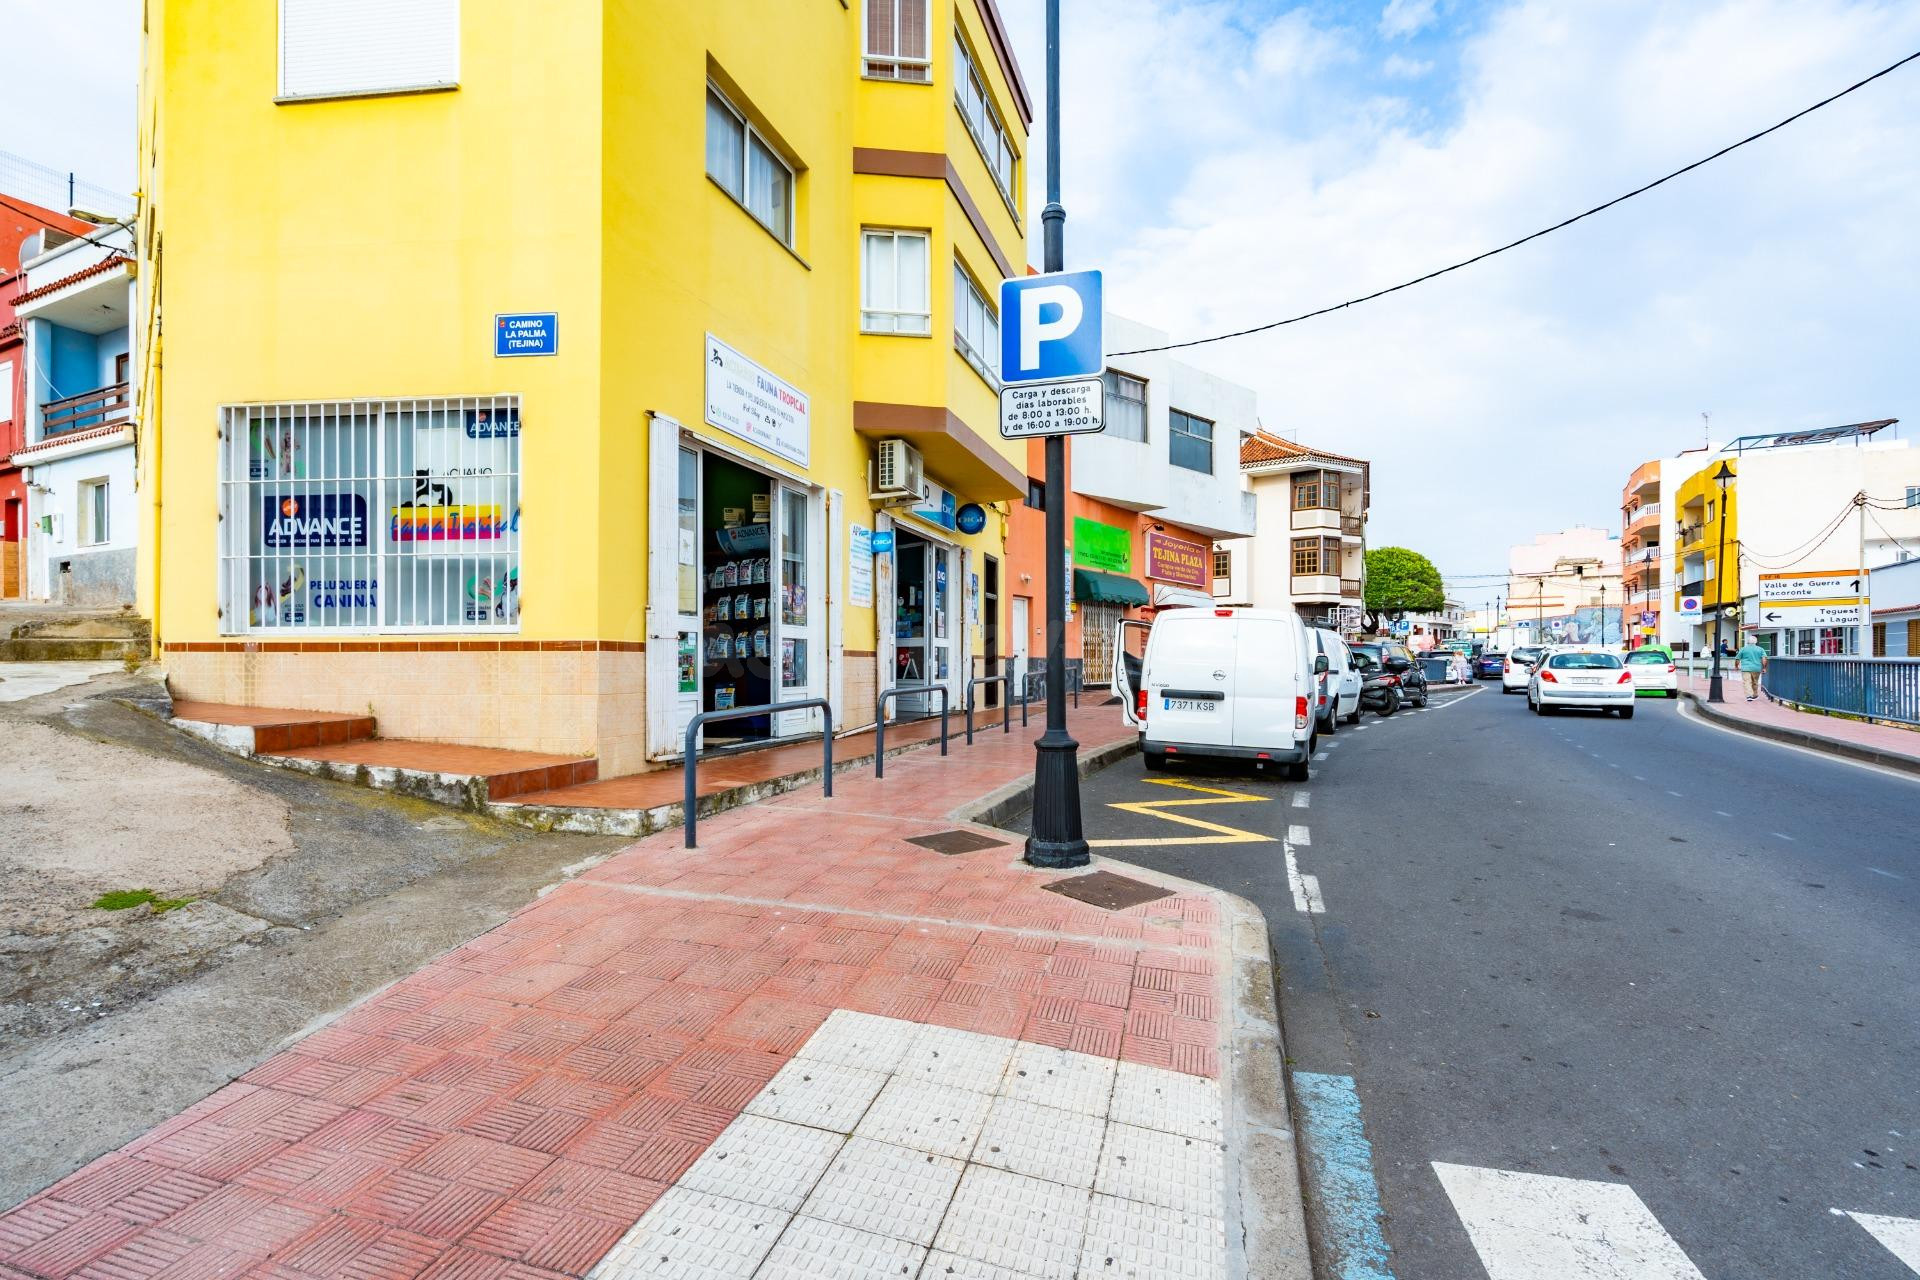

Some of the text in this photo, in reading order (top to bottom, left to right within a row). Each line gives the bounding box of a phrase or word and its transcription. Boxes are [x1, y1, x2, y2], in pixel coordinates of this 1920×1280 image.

[509, 320, 543, 328] CAMINO
[1020, 285, 1083, 371] P
[518, 329, 547, 338] PALMA
[508, 339, 543, 349] (TEJINA)
[756, 375, 806, 415] FAUNA TROPICAL
[1012, 385, 1091, 399] Carga y descarga
[1038, 396, 1087, 407] laborables
[1008, 413, 1018, 421] de
[1022, 410, 1043, 419] 8:00
[1055, 407, 1080, 417] 13:00
[1084, 406, 1092, 414] h.
[470, 421, 520, 432] ADVANCE
[1004, 425, 1009, 433] y
[1013, 423, 1023, 431] de
[1027, 420, 1051, 430] 16:00
[1063, 417, 1088, 426] 19:00
[1092, 416, 1100, 424] h.
[268, 517, 362, 536] ADVANCE
[737, 526, 766, 538] ADVANCE
[1153, 547, 1203, 569] TEJINA PLAZA
[310, 580, 378, 590] PELUQUERA
[1764, 589, 1812, 597] Tacoronte
[314, 594, 376, 608] CANINA
[1830, 616, 1859, 624] Lagun
[1171, 700, 1215, 711] 7371 KSB
